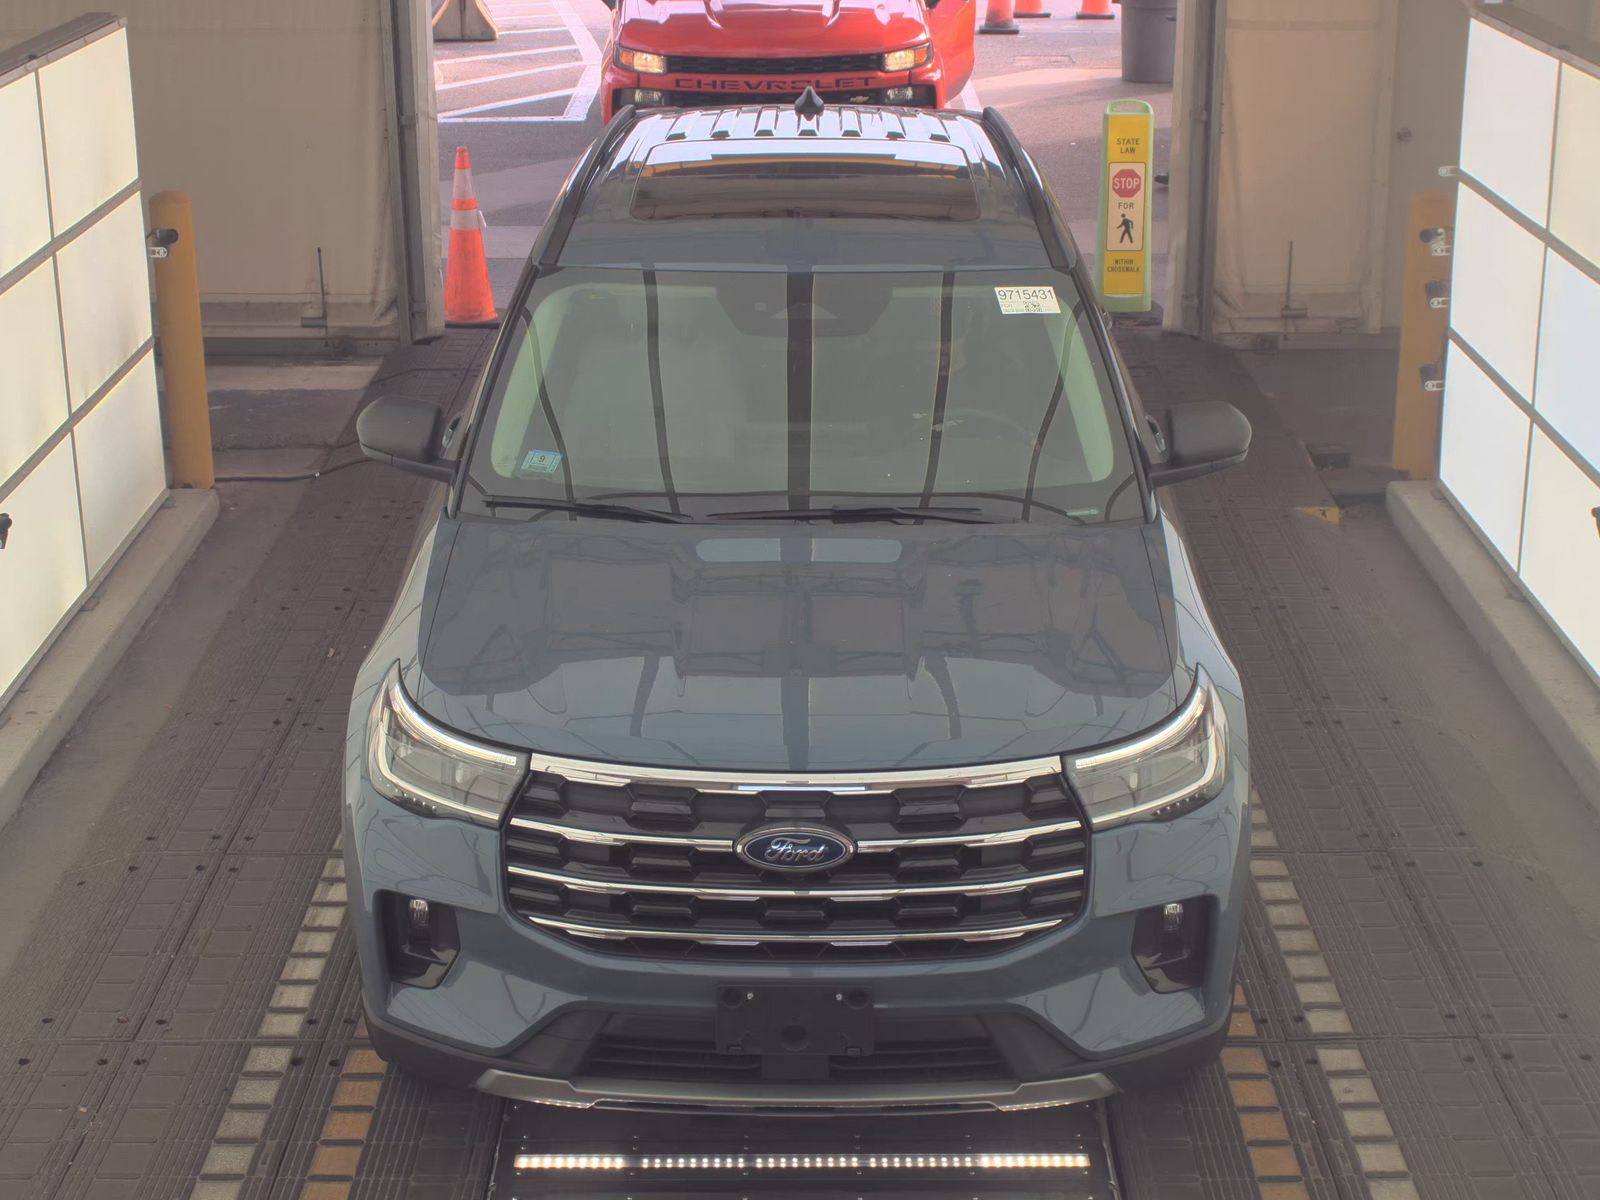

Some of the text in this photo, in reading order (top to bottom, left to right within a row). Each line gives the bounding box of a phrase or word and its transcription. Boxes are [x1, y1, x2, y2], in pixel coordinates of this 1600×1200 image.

[674, 76, 876, 91] CHEVROLET
[1113, 177, 1140, 190] STOP
[1118, 201, 1134, 209] FOR
[998, 289, 1054, 301] 9715431
[764, 837, 825, 863] Ford
